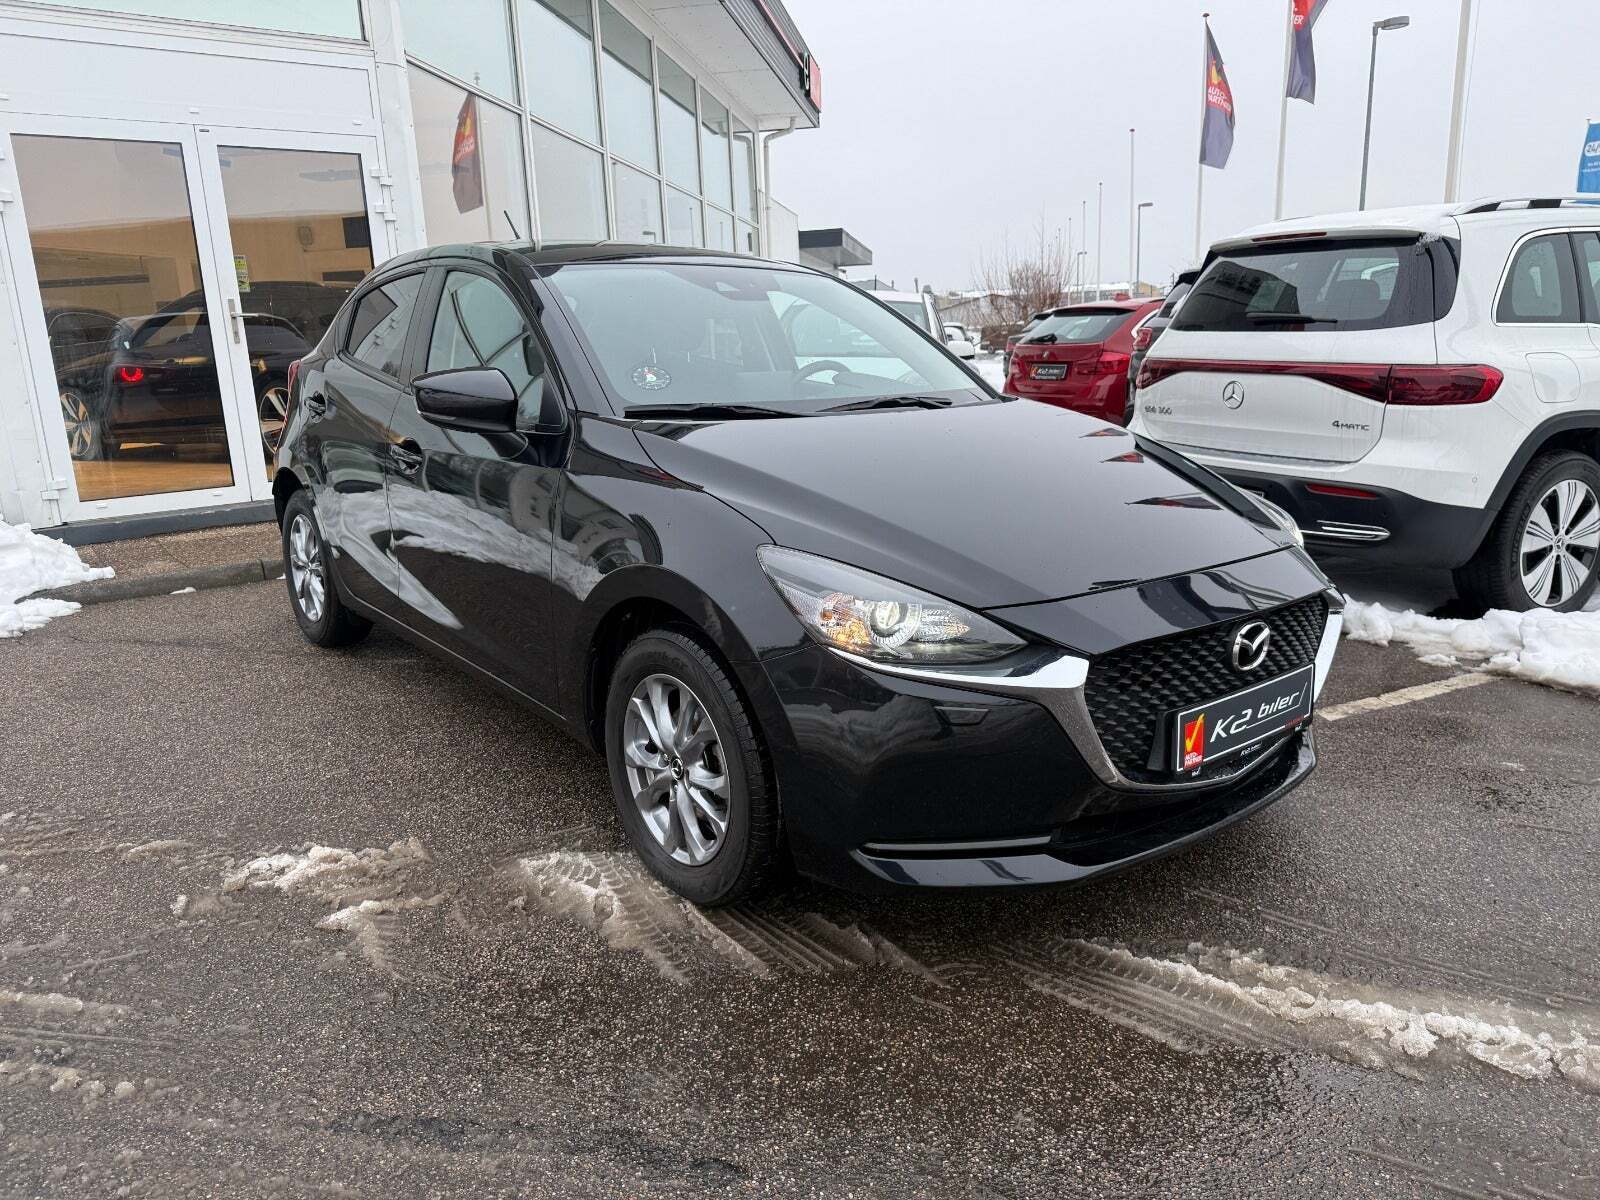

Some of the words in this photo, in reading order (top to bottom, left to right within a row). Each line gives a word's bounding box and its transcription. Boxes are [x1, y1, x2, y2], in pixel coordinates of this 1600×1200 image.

[1332, 420, 1370, 431] 4MATIC
[1210, 709, 1252, 743] K2
[1257, 692, 1299, 719] biler
